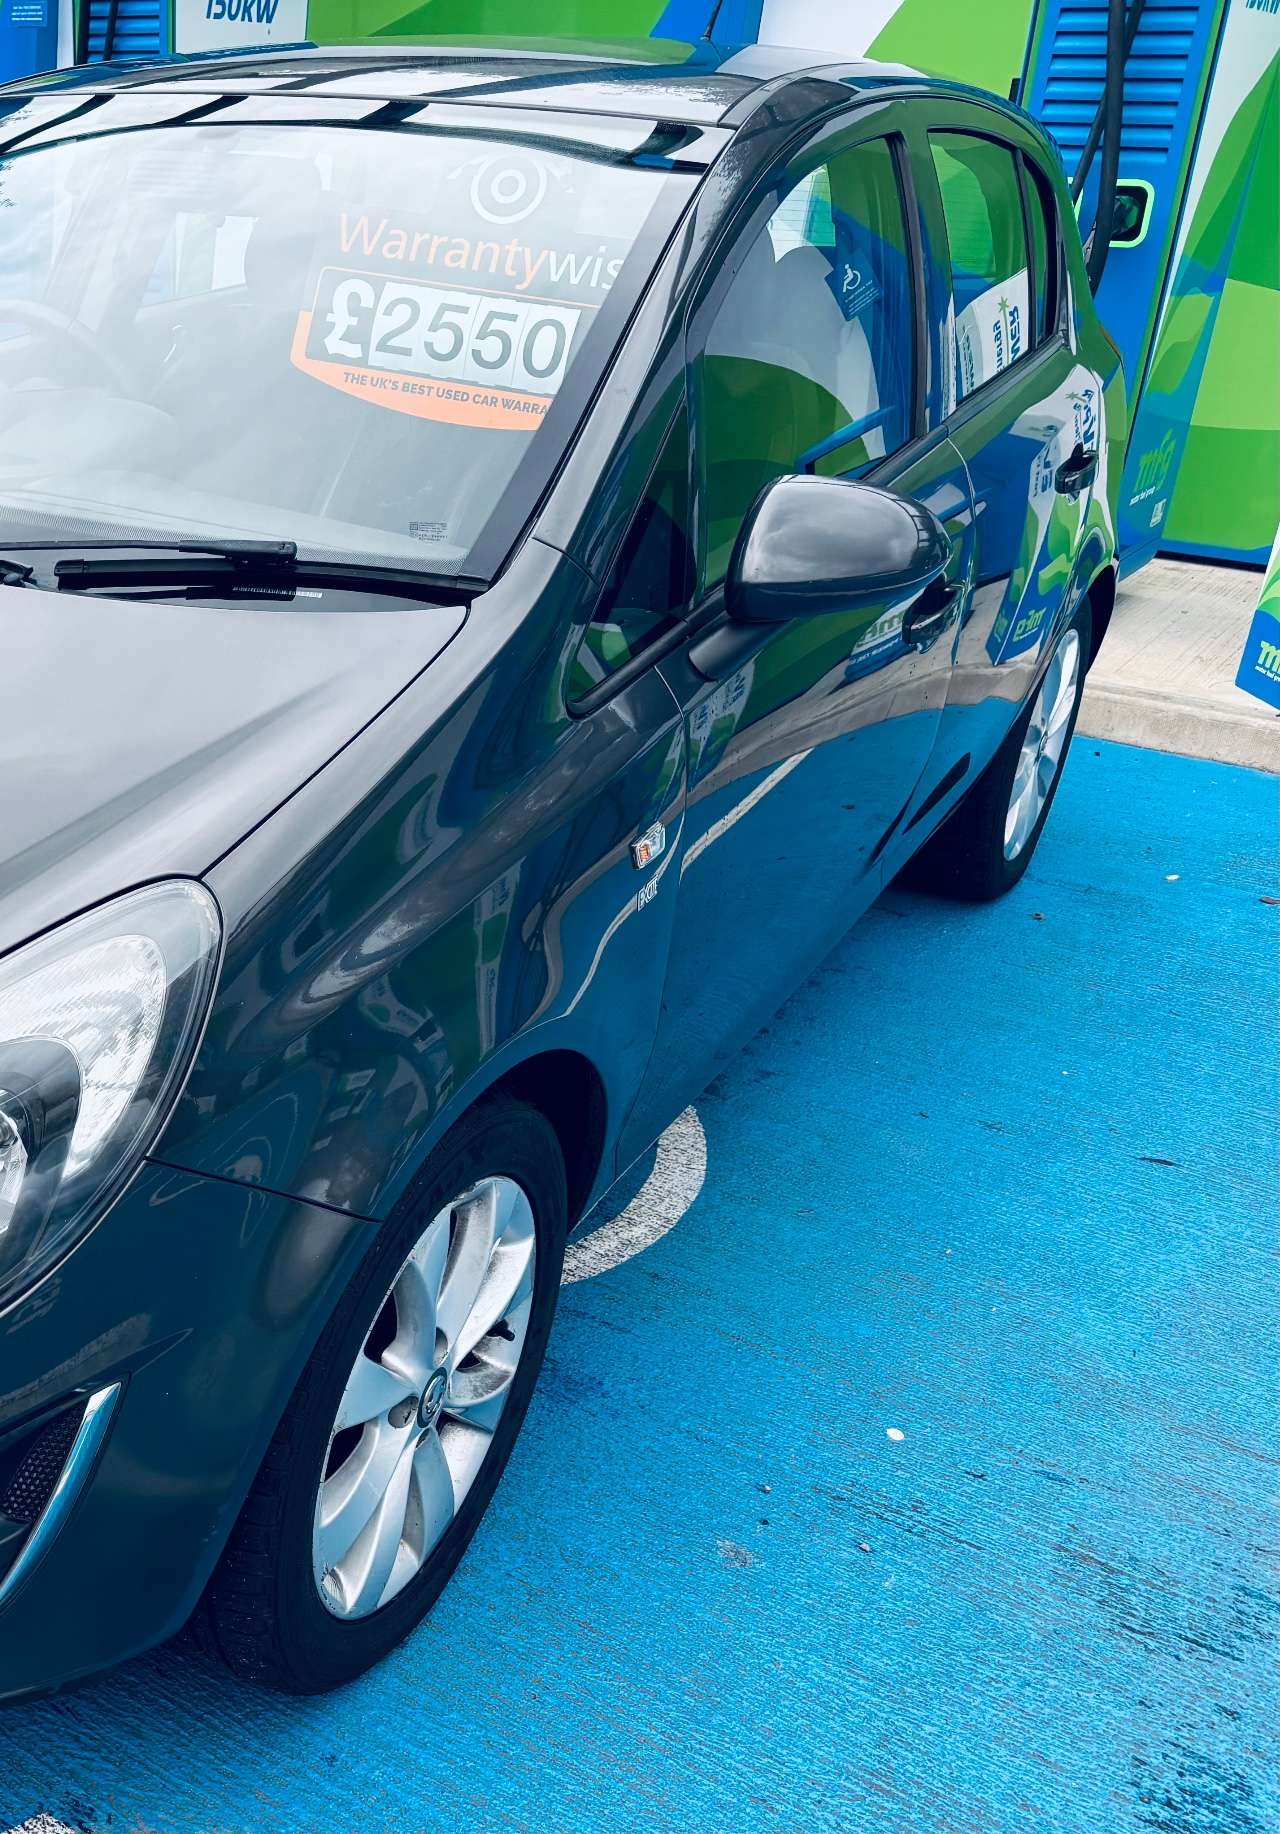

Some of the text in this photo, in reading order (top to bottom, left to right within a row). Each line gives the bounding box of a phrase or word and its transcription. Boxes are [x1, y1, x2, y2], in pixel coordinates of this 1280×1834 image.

[324, 278, 567, 379] £2550
[343, 372, 367, 386] THE
[370, 375, 399, 390] UK'S
[402, 382, 434, 397] BEST
[436, 388, 469, 402] USED
[472, 394, 498, 408] CAR
